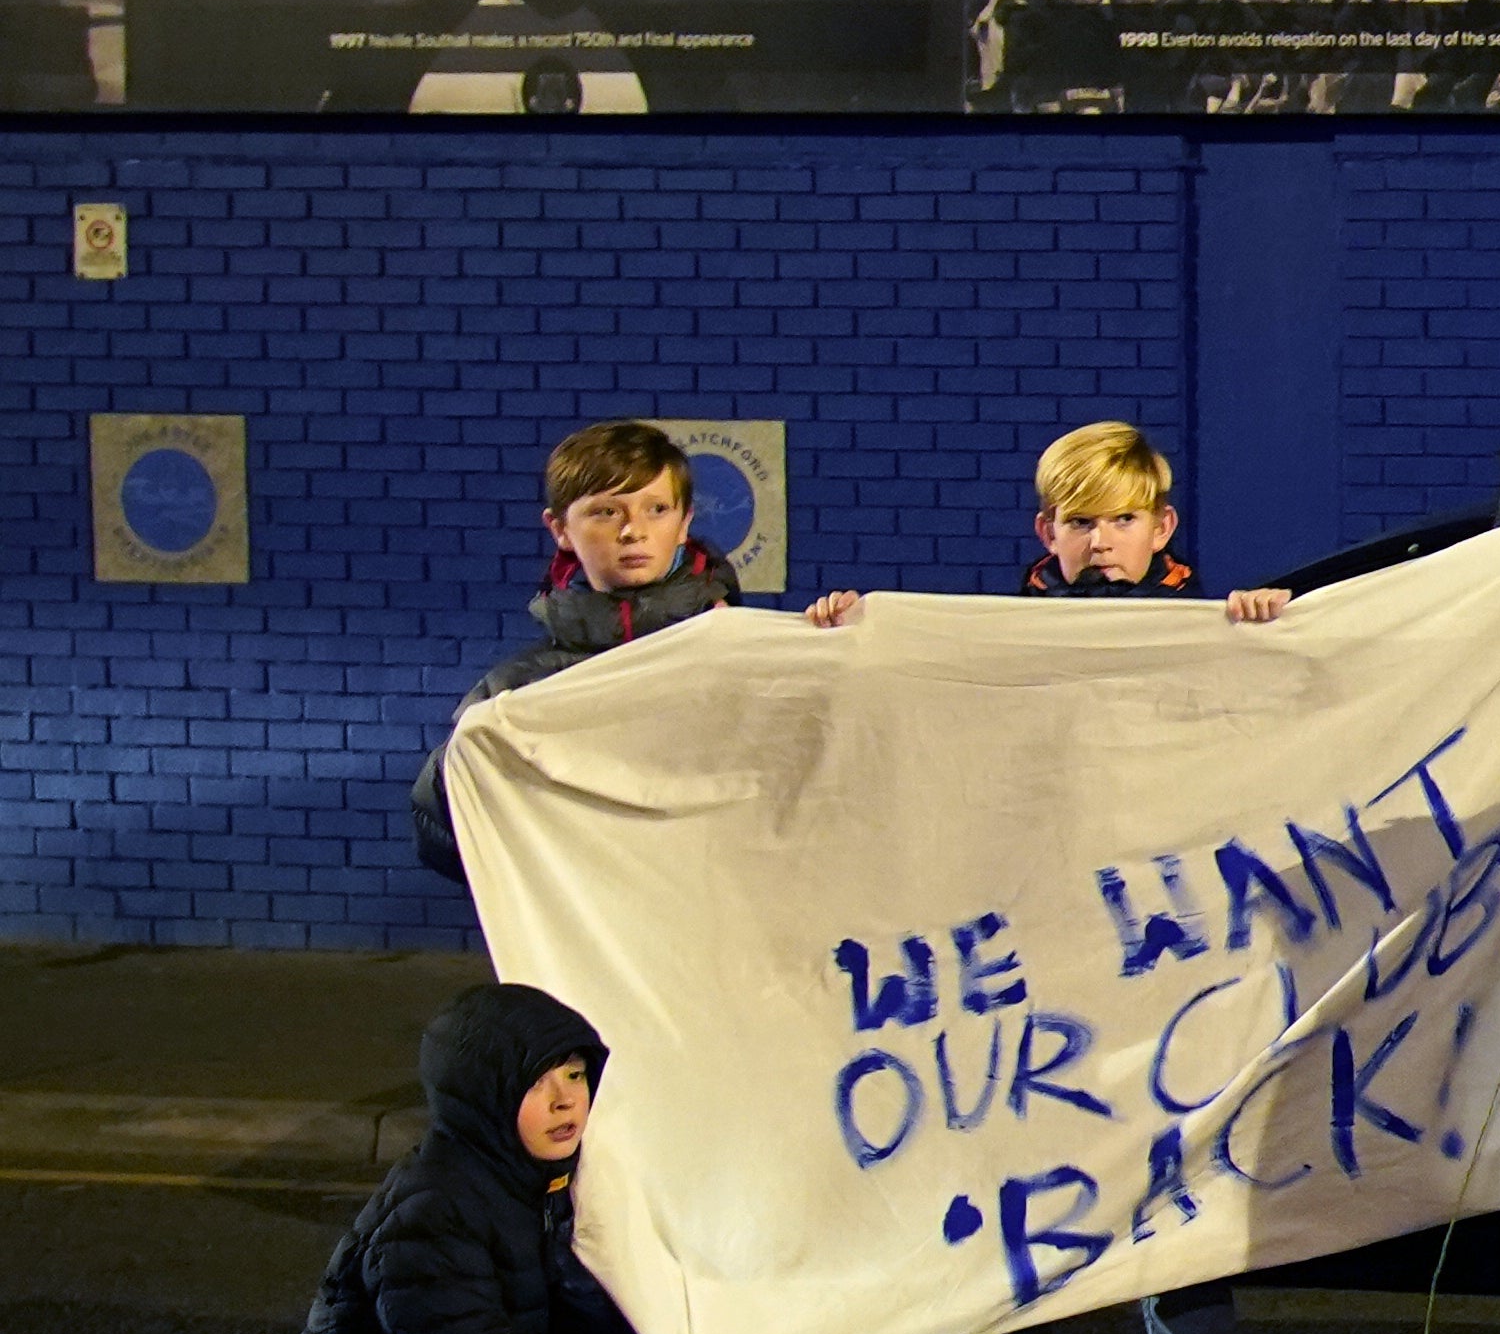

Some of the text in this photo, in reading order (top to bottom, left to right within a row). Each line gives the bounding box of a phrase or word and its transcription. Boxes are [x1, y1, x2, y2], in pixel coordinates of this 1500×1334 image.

[1119, 31, 1159, 48] 1998
[1161, 32, 1216, 48] Everton
[1218, 31, 1264, 48] avoids
[1266, 31, 1336, 50] relegation
[1338, 34, 1358, 47] on
[1359, 31, 1385, 47] the
[1386, 31, 1412, 47] last
[1415, 31, 1441, 50] day
[1443, 31, 1460, 47] of
[1461, 31, 1485, 47] the
[832, 725, 1467, 1032] WE WANT
[834, 1011, 1123, 1170] OUR
